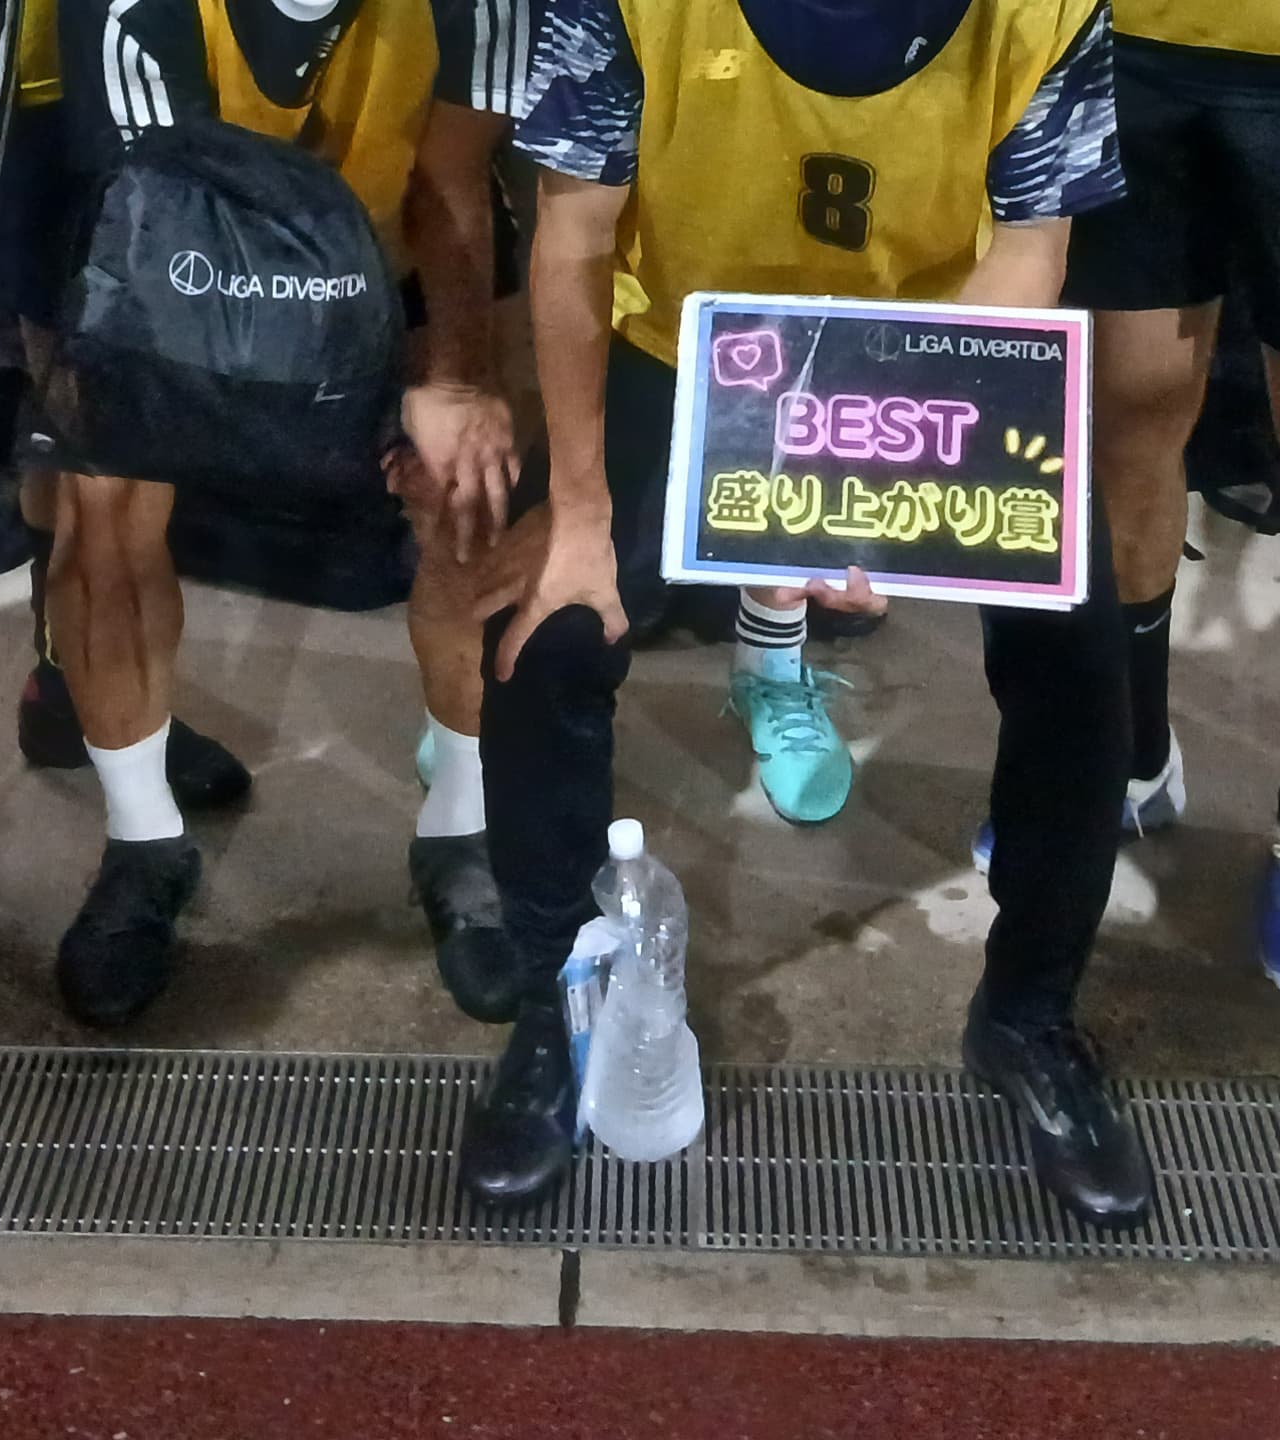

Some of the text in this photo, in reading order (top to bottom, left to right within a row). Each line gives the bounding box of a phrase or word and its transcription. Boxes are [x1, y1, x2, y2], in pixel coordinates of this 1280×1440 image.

[797, 152, 877, 253] 8
[774, 391, 980, 466] BEST
[707, 470, 1059, 553] 盛り上がり賞
